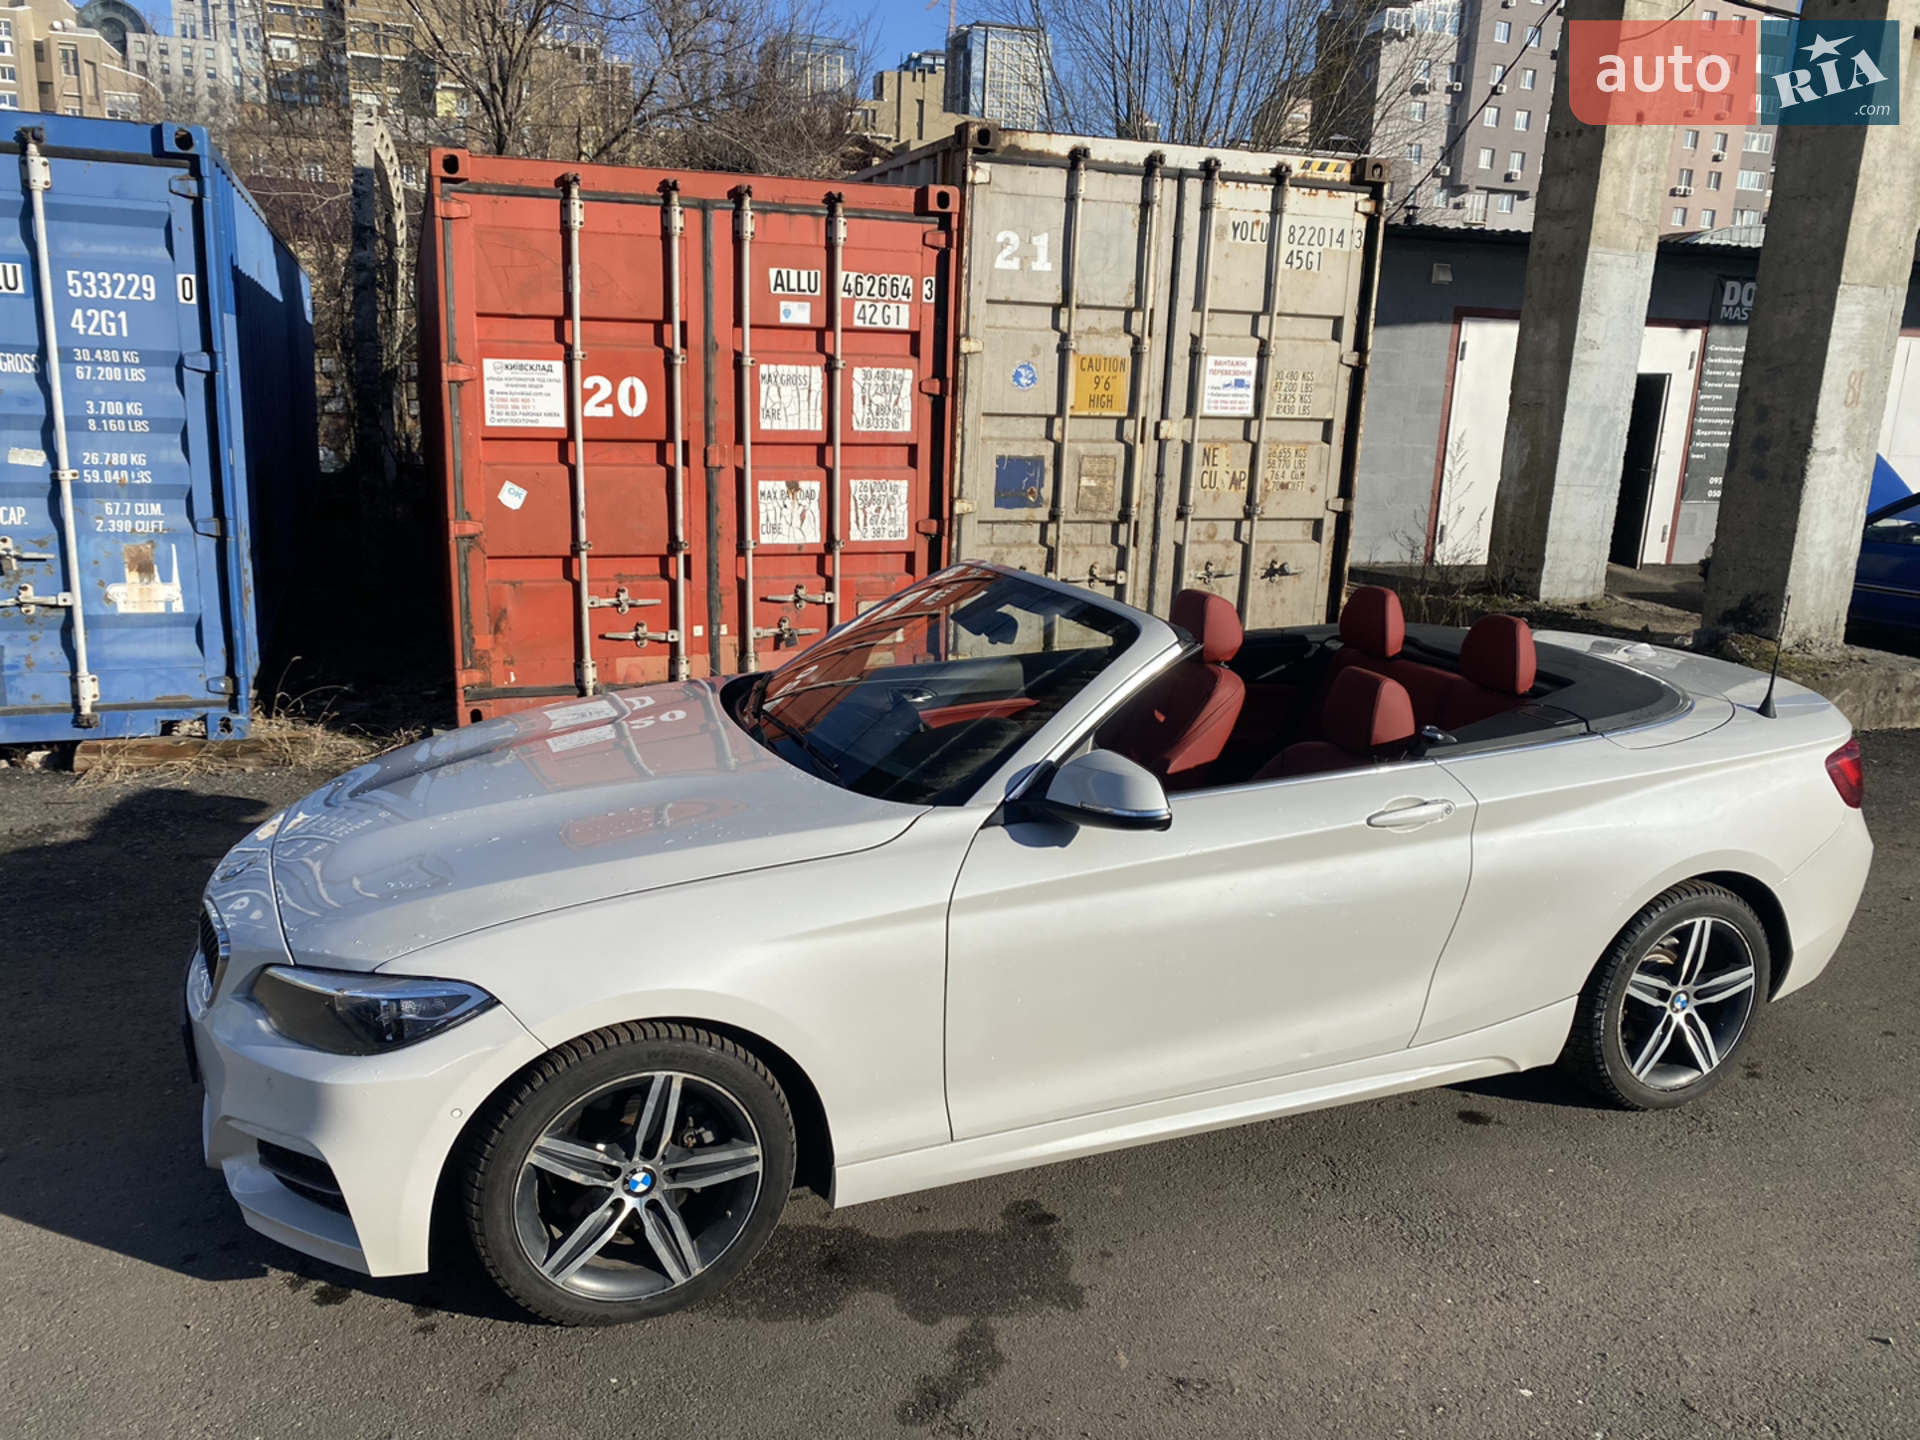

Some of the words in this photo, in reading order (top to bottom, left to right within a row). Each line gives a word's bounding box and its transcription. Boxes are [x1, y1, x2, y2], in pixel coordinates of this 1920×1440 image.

[1231, 220, 1269, 243] YOLU
[1287, 224, 1345, 249] 822014
[1354, 228, 1364, 249] 3
[994, 230, 1052, 272] 21
[1285, 250, 1322, 271] 45G1
[0, 264, 19, 291] U
[66, 269, 156, 301] 533229
[181, 276, 194, 302] 0
[773, 270, 819, 294] ALLU
[842, 273, 912, 300] 462664
[924, 278, 934, 300] 3
[70, 308, 129, 337] 42G1
[856, 304, 901, 326] 42G1
[0, 352, 41, 374] GROSS
[73, 348, 120, 363] 30.480
[122, 350, 140, 364] KG
[504, 362, 553, 373] КИЇВСКЛАД
[1080, 356, 1126, 373] CAUTION
[75, 365, 123, 381] 67.200
[124, 367, 147, 382] LBS
[760, 374, 777, 385] MAX
[780, 374, 808, 386] GROSS
[861, 369, 873, 381] 30
[582, 374, 648, 418] 20
[1088, 394, 1114, 409] HIGH
[86, 400, 124, 415] 3.700
[126, 402, 144, 416] KG
[761, 408, 782, 421] TARE
[88, 419, 126, 432] 8.160
[128, 420, 150, 433] LBS
[82, 452, 128, 466] 26.780
[130, 453, 147, 466] KG
[83, 469, 129, 484] 59.040
[507, 487, 523, 499] OK
[759, 489, 777, 501] MAX
[858, 482, 869, 493] 26
[0, 506, 29, 525] CAP.
[104, 502, 131, 516] 67.7
[95, 519, 133, 533] 2.390
[760, 523, 782, 536] CUBE
